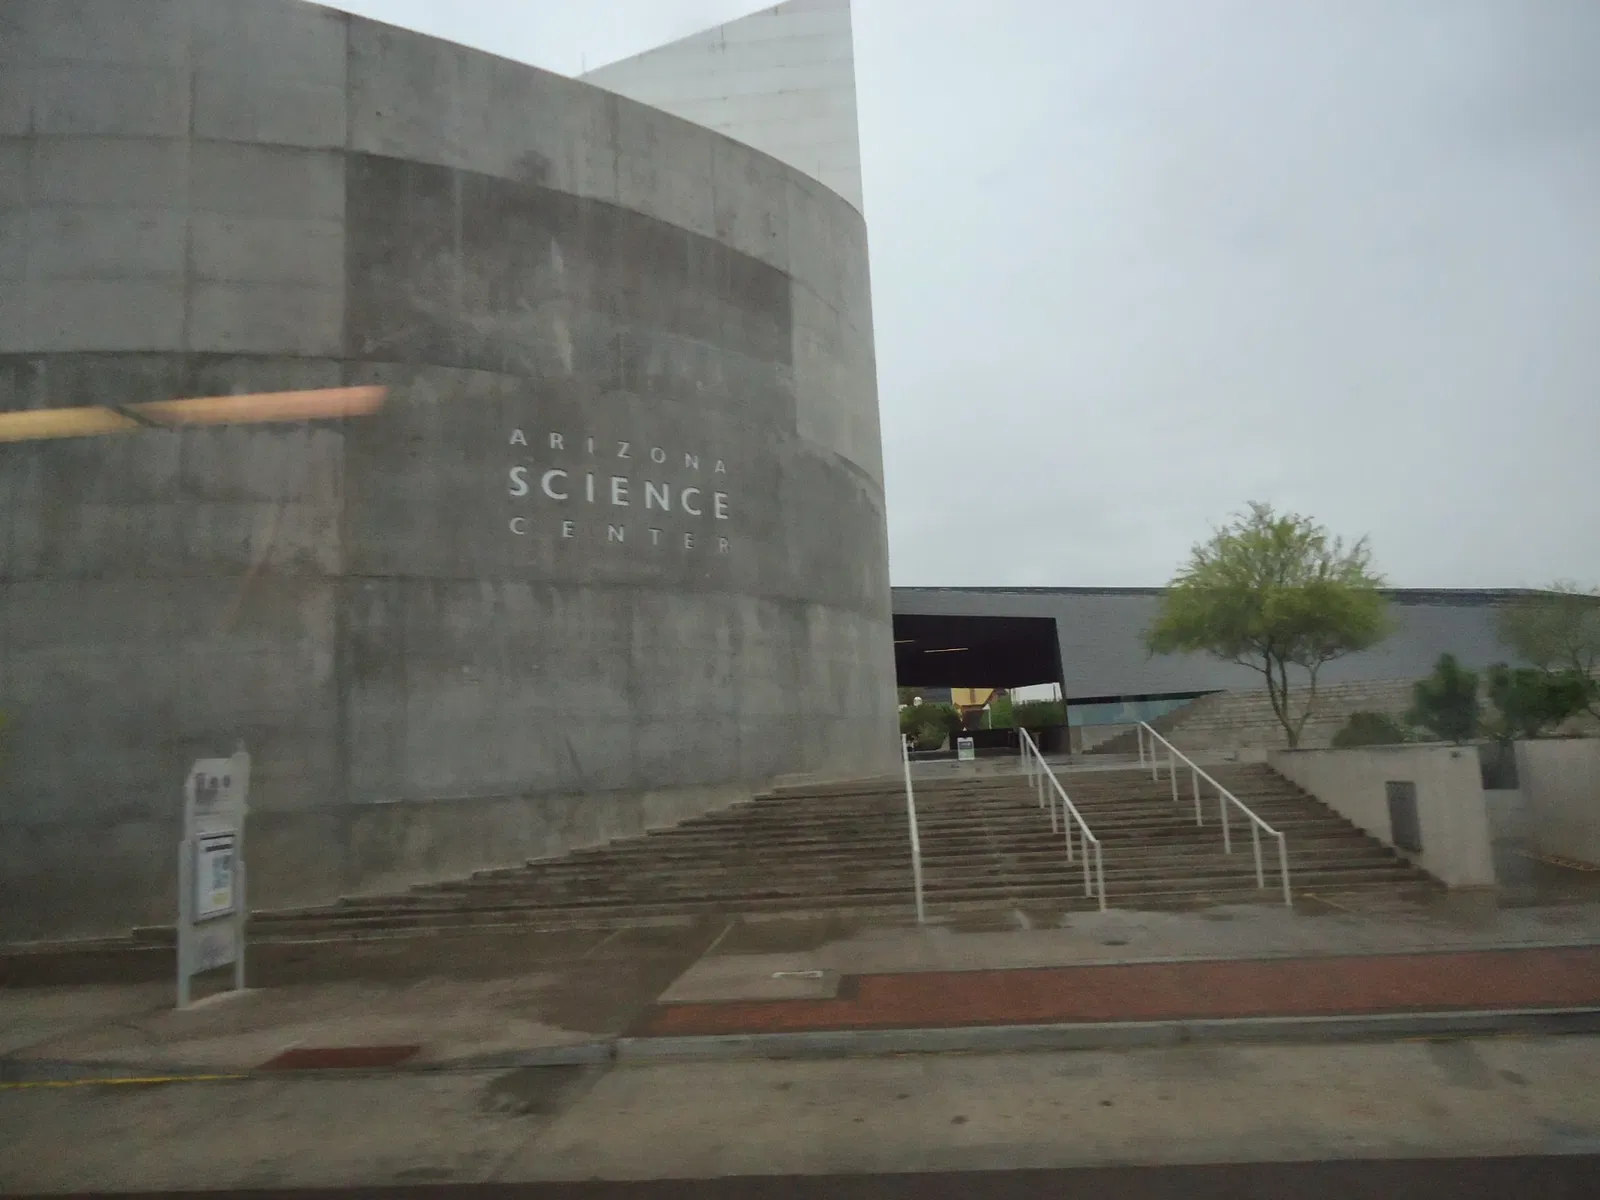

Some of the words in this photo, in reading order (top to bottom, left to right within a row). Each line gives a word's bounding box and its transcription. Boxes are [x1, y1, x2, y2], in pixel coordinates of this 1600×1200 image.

[509, 428, 726, 475] ARIZONA
[508, 465, 729, 520] SCIENCE
[509, 516, 729, 553] CENTER
